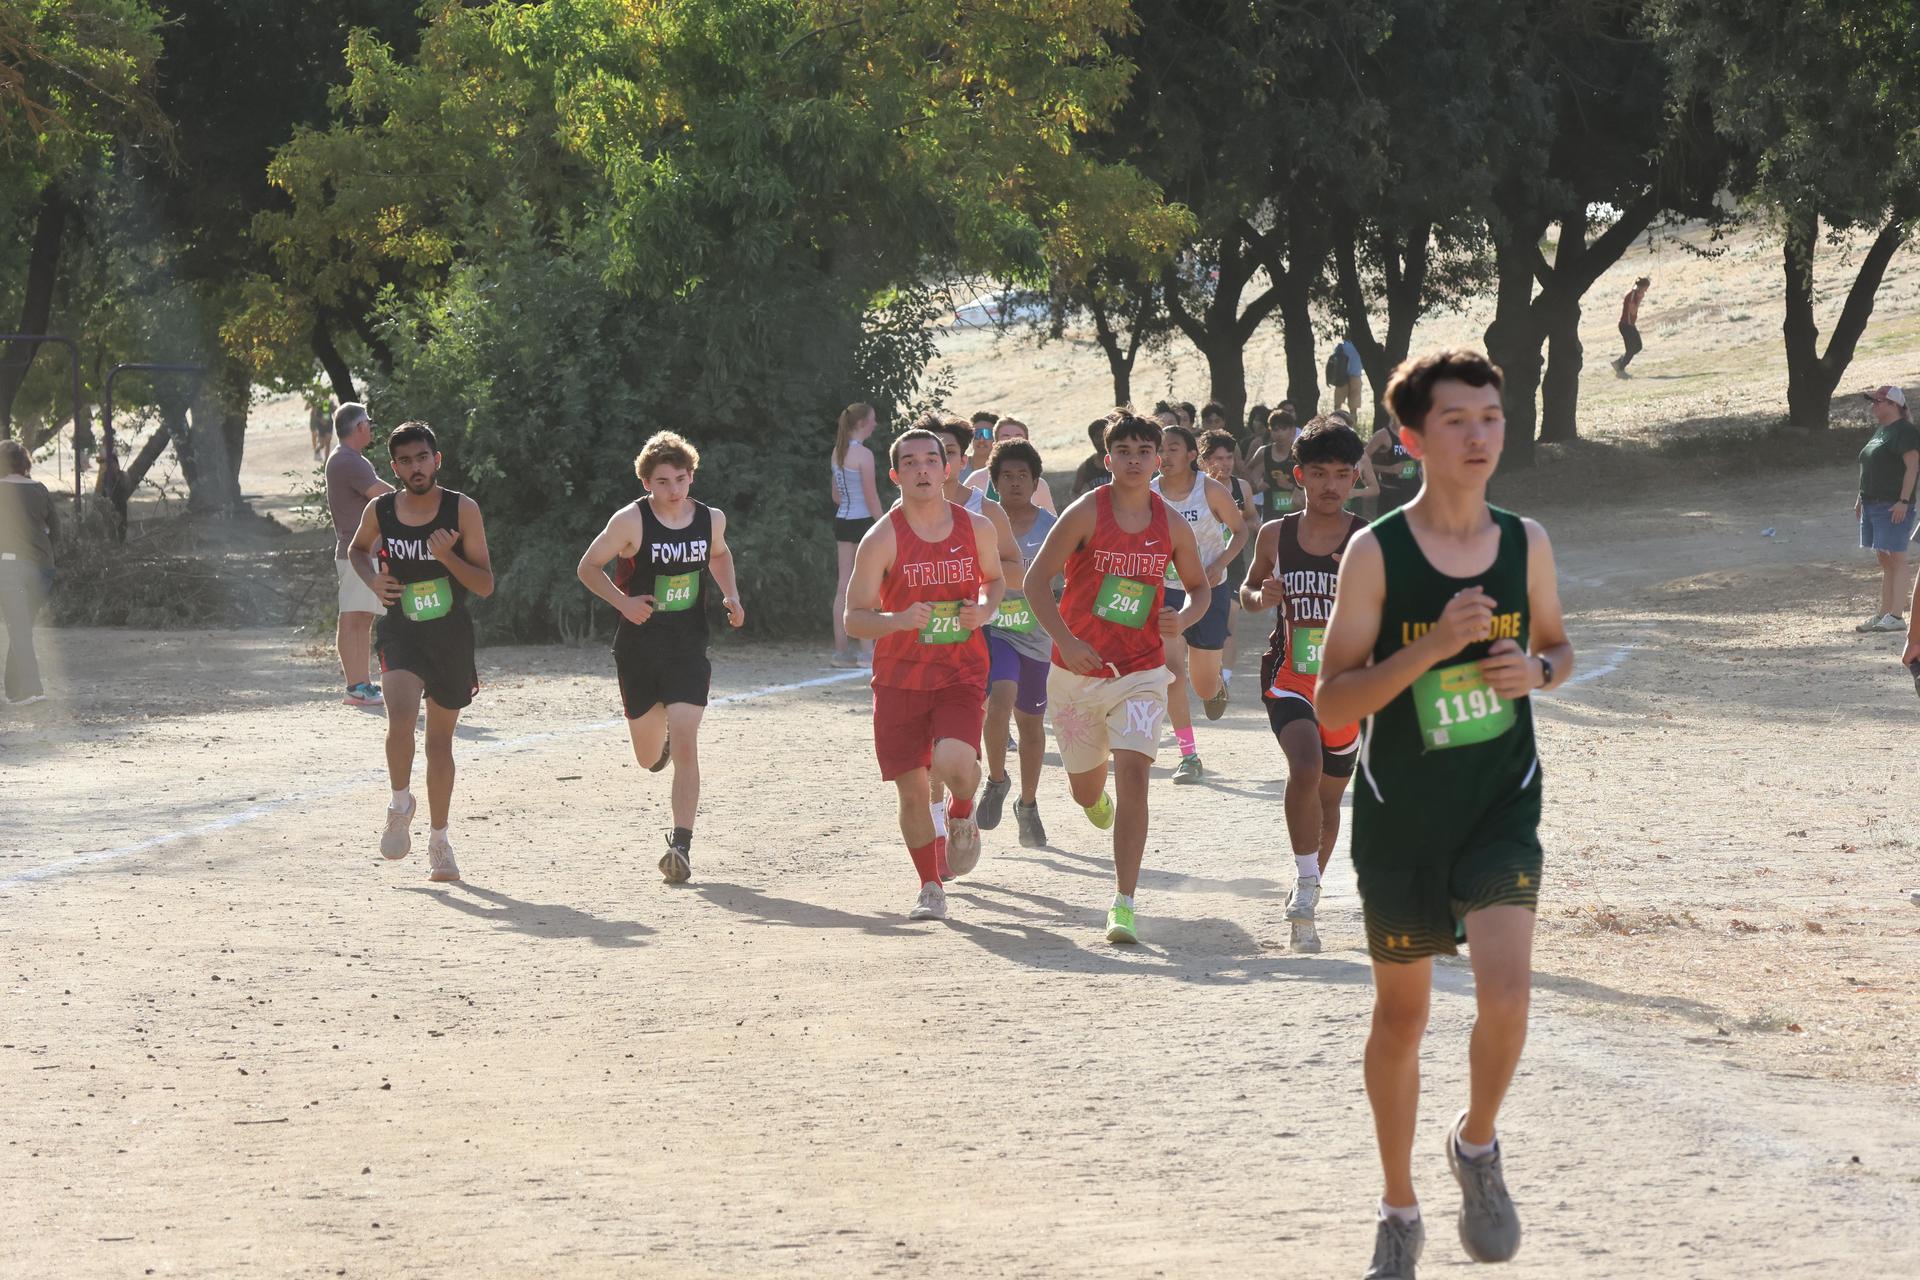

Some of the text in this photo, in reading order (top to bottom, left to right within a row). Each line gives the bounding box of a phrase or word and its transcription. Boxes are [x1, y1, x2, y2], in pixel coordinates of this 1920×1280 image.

[651, 540, 708, 564] FOWLER
[1093, 549, 1168, 578] TRIBE
[903, 557, 975, 587] TRIBE
[1283, 570, 1338, 597] HORNE
[414, 593, 441, 611] 641
[666, 587, 691, 602] 644
[1108, 593, 1141, 615] 294
[997, 611, 1030, 628] 2042
[1291, 597, 1333, 621] TOAD
[932, 616, 961, 633] 279
[1402, 612, 1521, 647] LIVORE
[1435, 687, 1502, 726] 1191
[1122, 699, 1164, 741] NY
